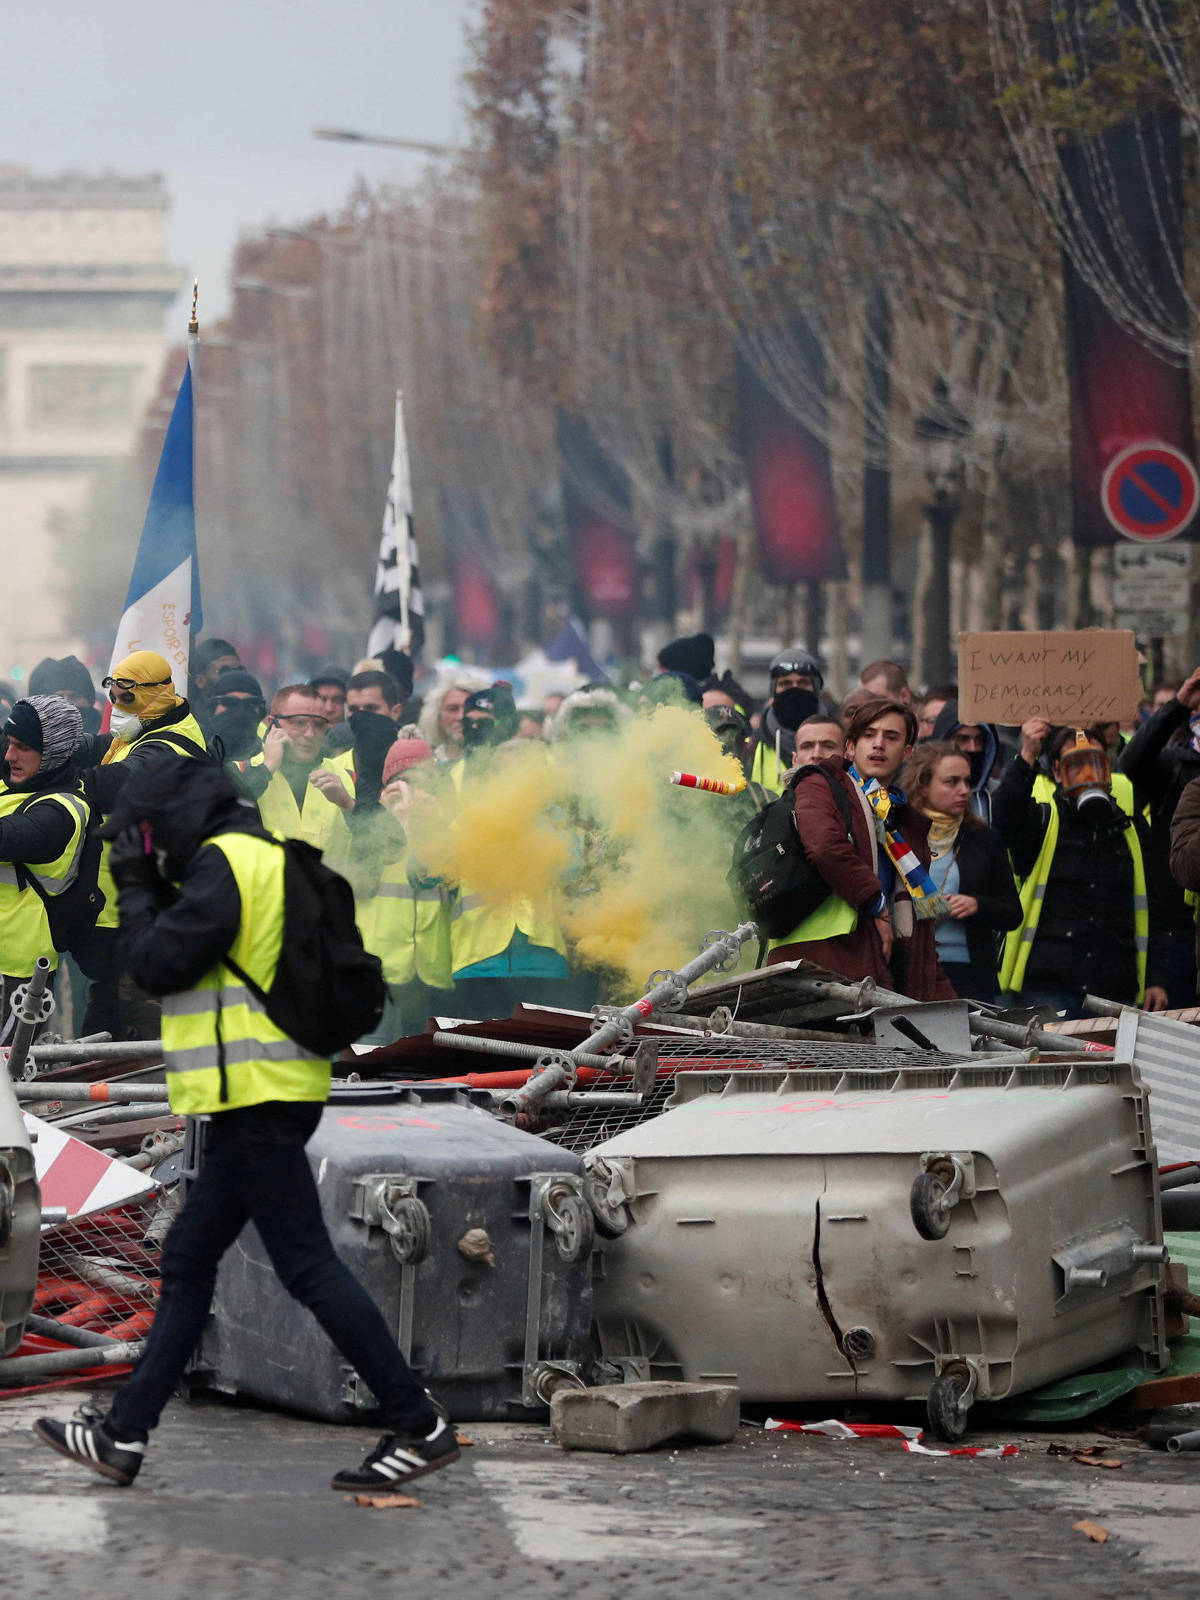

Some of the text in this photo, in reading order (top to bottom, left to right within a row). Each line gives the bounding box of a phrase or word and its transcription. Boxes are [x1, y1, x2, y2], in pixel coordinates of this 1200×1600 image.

[970, 649, 1096, 671] I WANT MY
[974, 682, 1093, 703] DEMOCRACY
